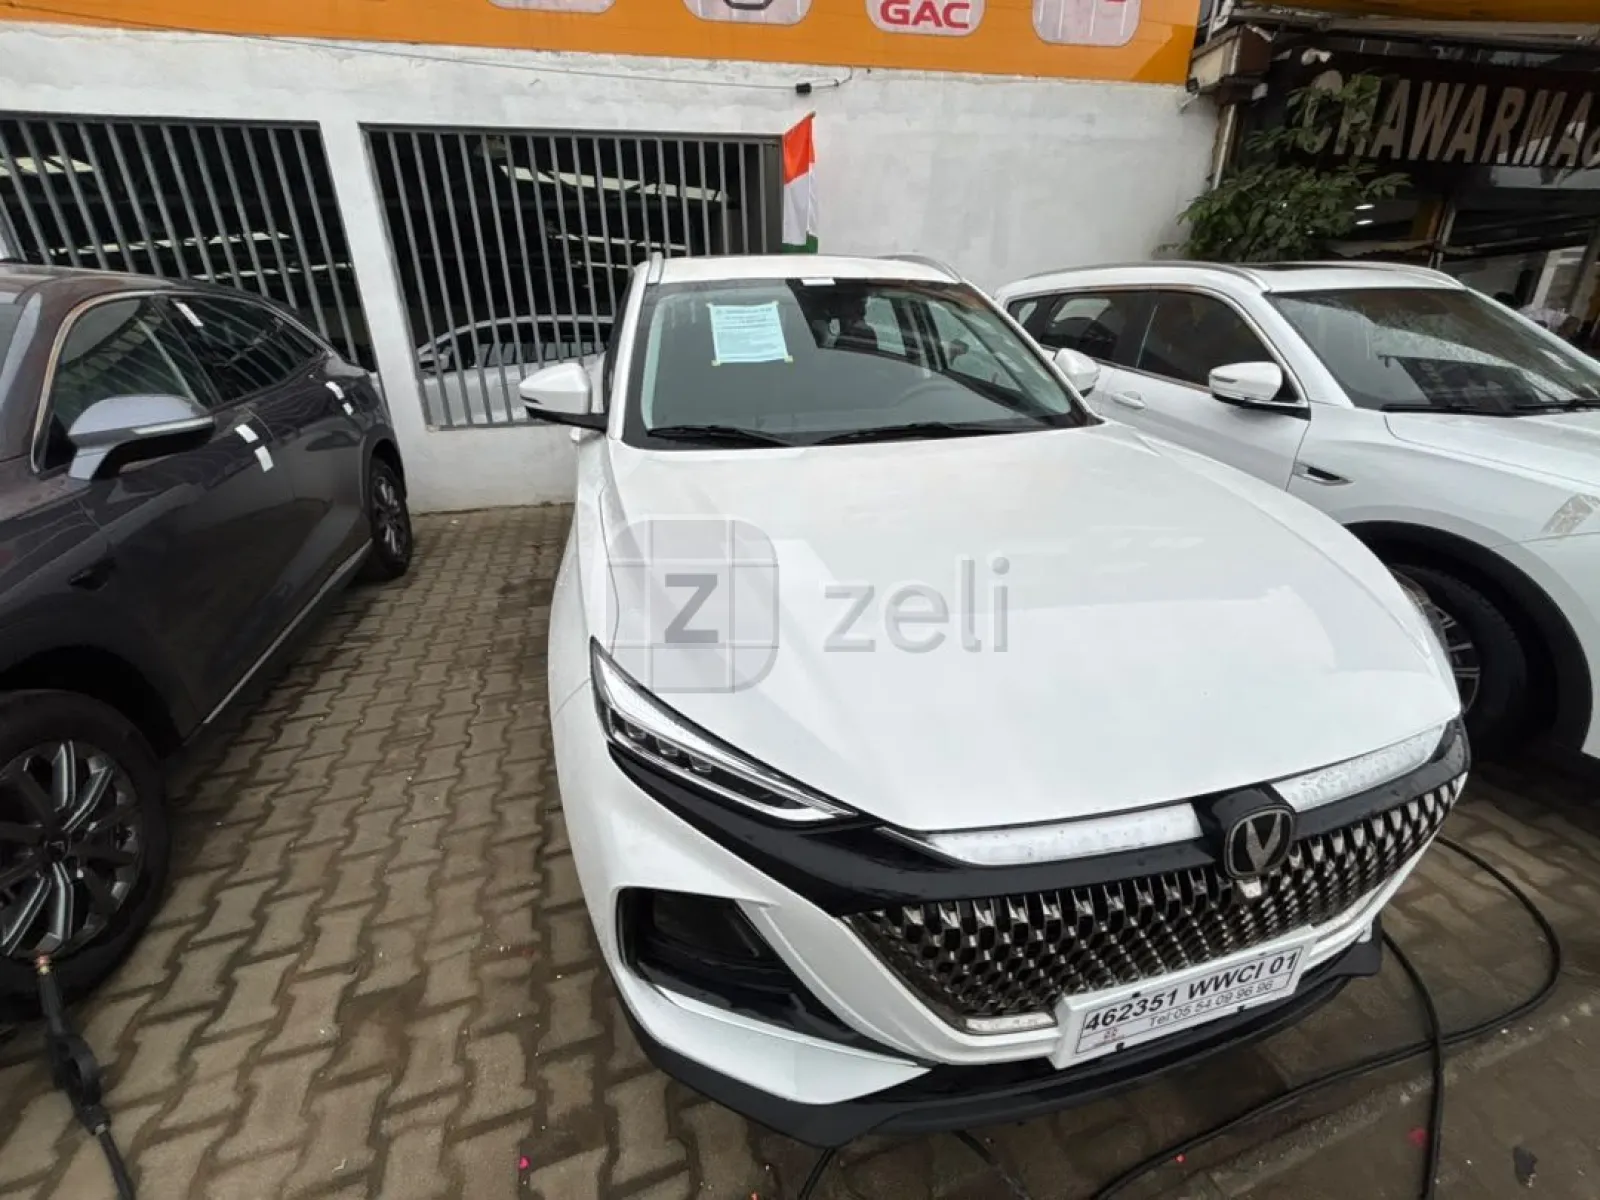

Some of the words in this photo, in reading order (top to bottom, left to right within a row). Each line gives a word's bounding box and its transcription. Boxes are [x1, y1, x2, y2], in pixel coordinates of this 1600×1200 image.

[880, 0, 969, 28] GAC
[1085, 989, 1178, 1030] 462351
[1188, 963, 1264, 999] WWCI
[1269, 952, 1297, 975] 01
